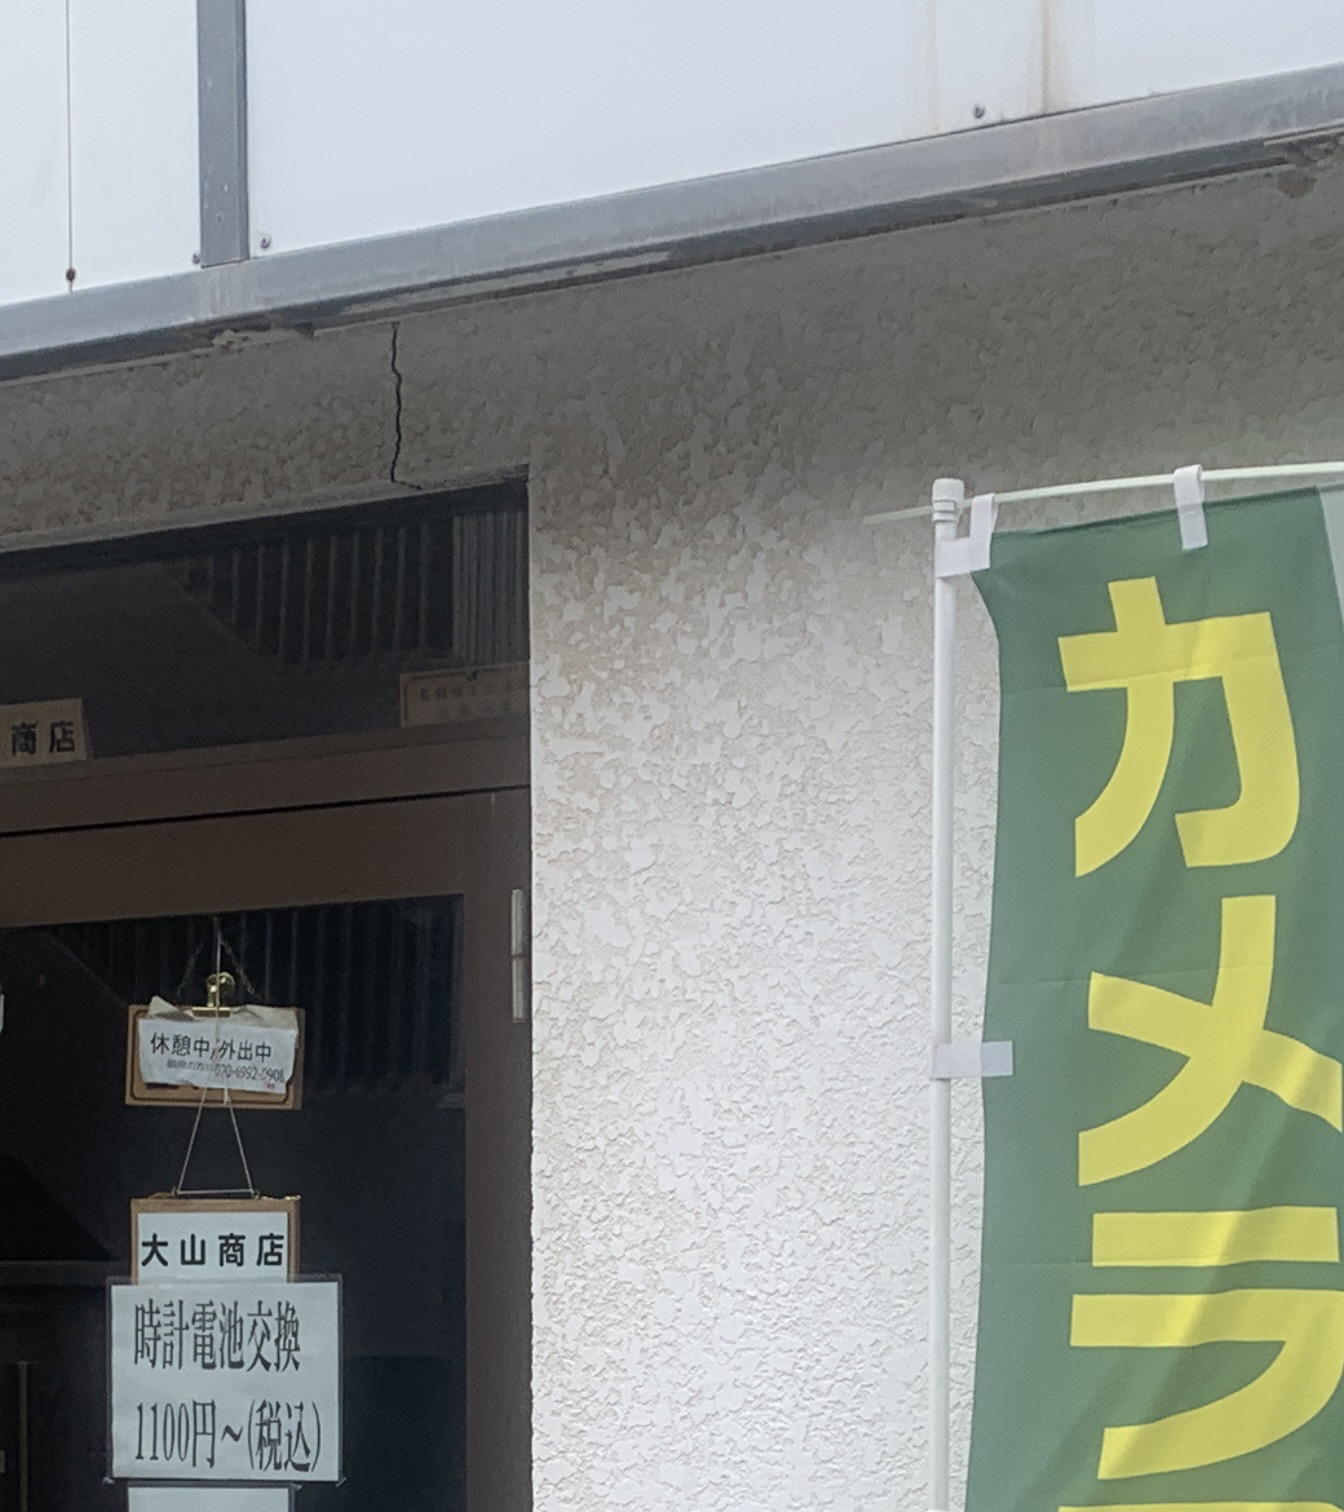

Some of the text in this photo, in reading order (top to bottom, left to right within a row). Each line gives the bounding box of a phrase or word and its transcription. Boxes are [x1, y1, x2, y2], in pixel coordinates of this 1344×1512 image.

[140, 1232, 285, 1267] 大山商店
[133, 1298, 301, 1373] 時計電池交換
